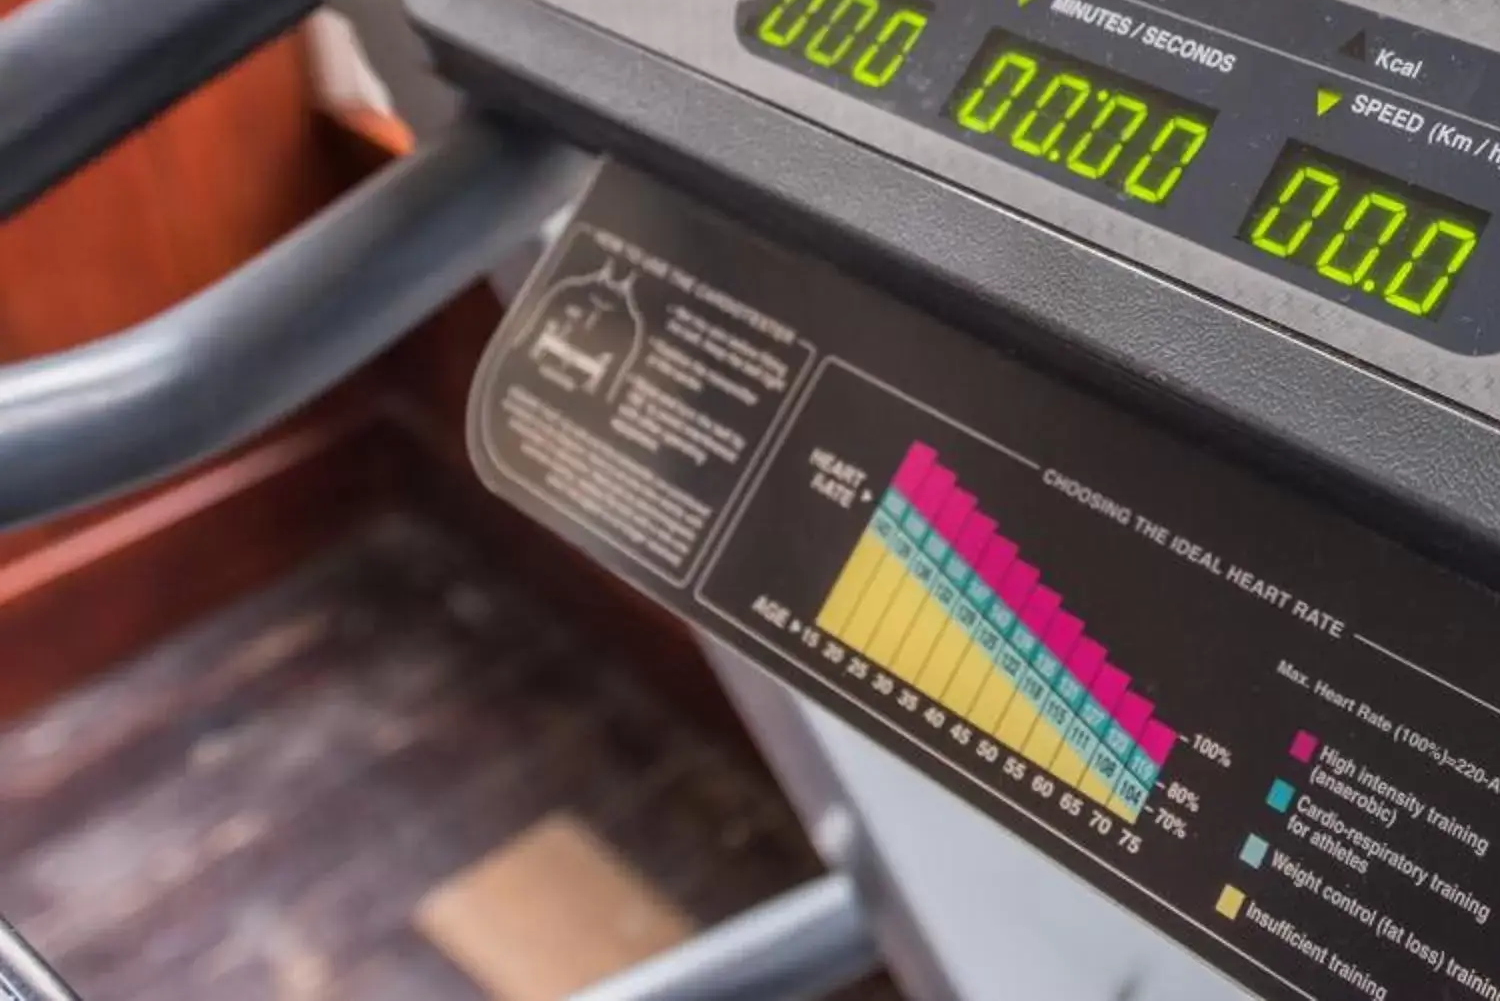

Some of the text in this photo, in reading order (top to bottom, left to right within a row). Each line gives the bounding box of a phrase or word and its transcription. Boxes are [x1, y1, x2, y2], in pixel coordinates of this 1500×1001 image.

[1142, 26, 1237, 74] SECONDS
[1375, 48, 1422, 79] Kcal
[1350, 94, 1425, 134] SPEED
[809, 447, 867, 489] HEART
[809, 472, 855, 509] RATE
[1041, 468, 1346, 639] CHOOSING THE IDEAL HEART RATE
[751, 594, 1143, 854] AGE 15 20 25 30 35 40 45 50 55 60 65 70 75
[1276, 659, 1310, 689] Max.
[1313, 679, 1356, 713] Heart
[1356, 701, 1393, 733] Rate
[1071, 723, 1091, 748] 111
[1121, 777, 1142, 805] 104
[1191, 734, 1233, 769] 100%
[1154, 808, 1187, 840] 70%
[1309, 765, 1397, 829] (anaerobic)
[1319, 745, 1356, 777] High
[1426, 806, 1490, 857] training
[1286, 814, 1369, 875] for athletes
[1296, 794, 1492, 925] Cardio-respiratory training
[1271, 849, 1324, 895] Weight
[1322, 884, 1378, 927] control
[1375, 915, 1405, 945] (fat
[1404, 931, 1445, 973] loss)
[1245, 899, 1388, 1001] Insufficient training
